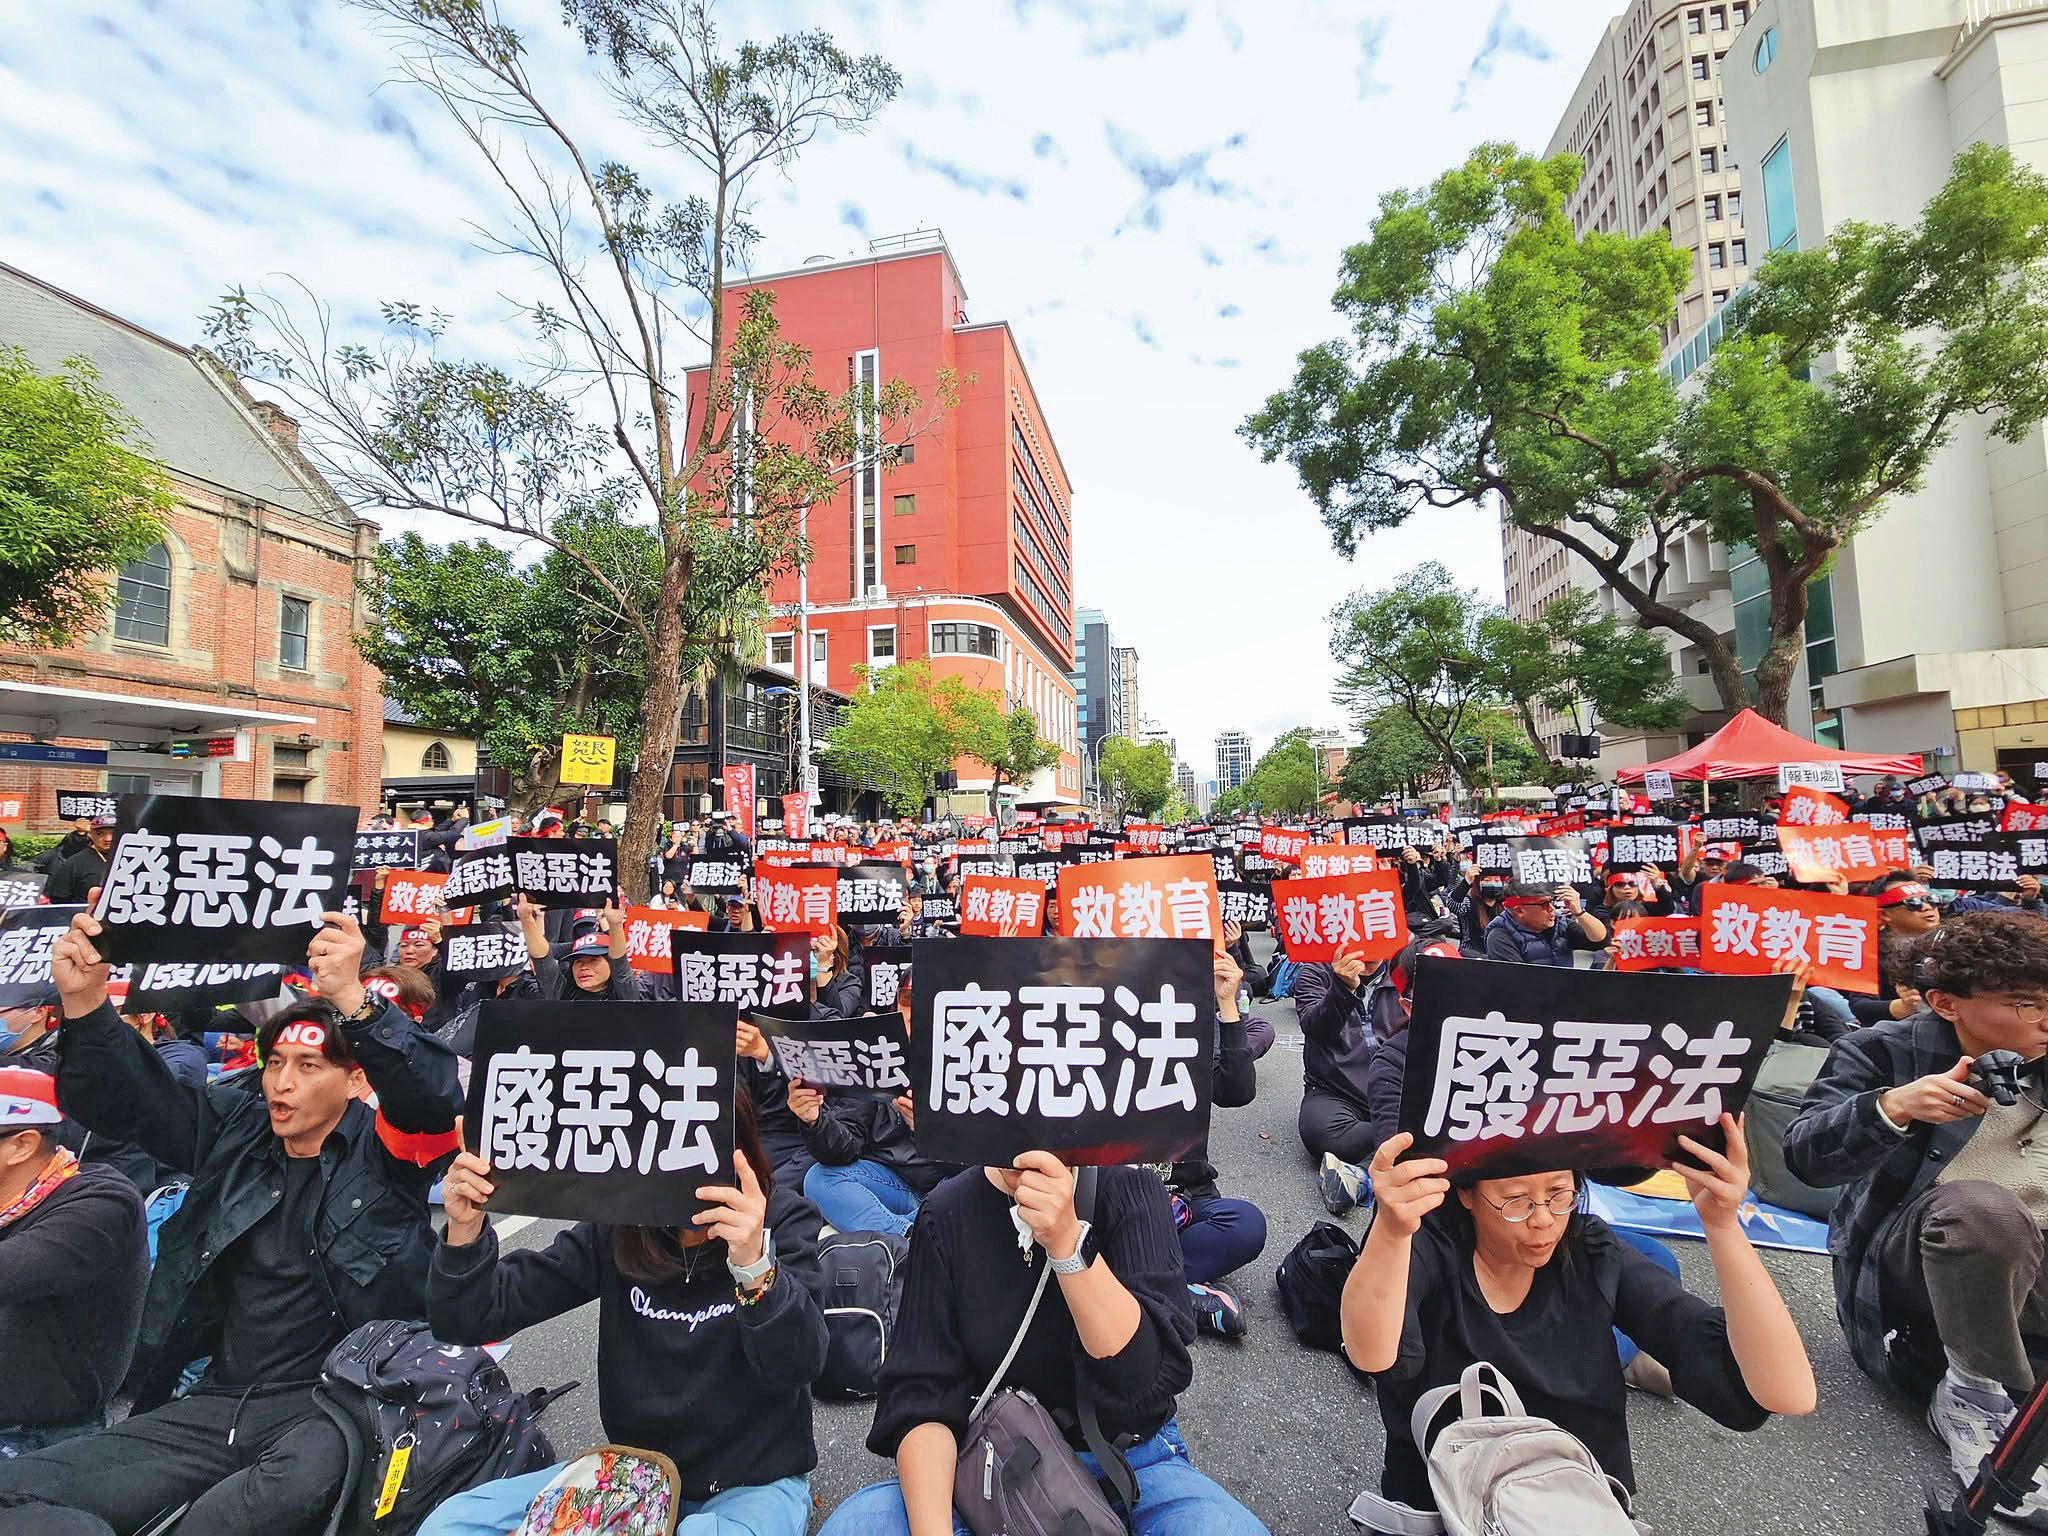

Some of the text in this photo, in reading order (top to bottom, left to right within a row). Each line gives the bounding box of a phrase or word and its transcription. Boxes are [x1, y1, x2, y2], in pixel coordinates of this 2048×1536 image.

[1787, 770, 1836, 782] 報到處
[0, 800, 20, 817] 育
[60, 796, 117, 816] 廢惡法
[355, 836, 415, 849] 息事寧人
[1129, 829, 1160, 846] 救教育
[1349, 823, 1406, 849] 廢惡法
[1703, 817, 1759, 838] 廢惡法
[355, 852, 415, 865] 才是殺人
[1263, 834, 1307, 857] 救教育
[1613, 834, 1677, 863] 廢惡法
[1789, 834, 1876, 869] 救教育
[2017, 839, 2048, 867] 惡
[94, 828, 334, 928] 廢惡法
[516, 851, 612, 893] 廢惡法
[690, 862, 742, 886] 廢惡法
[1212, 855, 1235, 881] 法
[1305, 854, 1373, 879] 救教育
[1517, 849, 1593, 884] 廢惡法
[1933, 849, 2018, 880] 廢惡法
[389, 880, 466, 918] 救教
[759, 876, 832, 925] 救教育
[837, 878, 903, 913] 廢惡法
[924, 899, 955, 918] 廢惡法
[966, 887, 1041, 927] 救教育
[1071, 877, 1211, 938] 救教育
[1283, 889, 1397, 944] 救教育
[446, 932, 530, 971] 廢惡法
[627, 920, 708, 957] 救教
[1618, 928, 1700, 960] 救教育
[1711, 902, 1867, 970] 救教育
[367, 979, 399, 997] NO
[680, 951, 804, 1010] 廢惡法
[277, 1026, 325, 1046] NO
[929, 982, 1199, 1117] 廢惡法
[771, 1035, 911, 1089] 廢惡法
[1424, 1011, 1752, 1141] 廢惡法
[479, 1045, 720, 1175] 廢惡法
[630, 1286, 736, 1332] Champion
